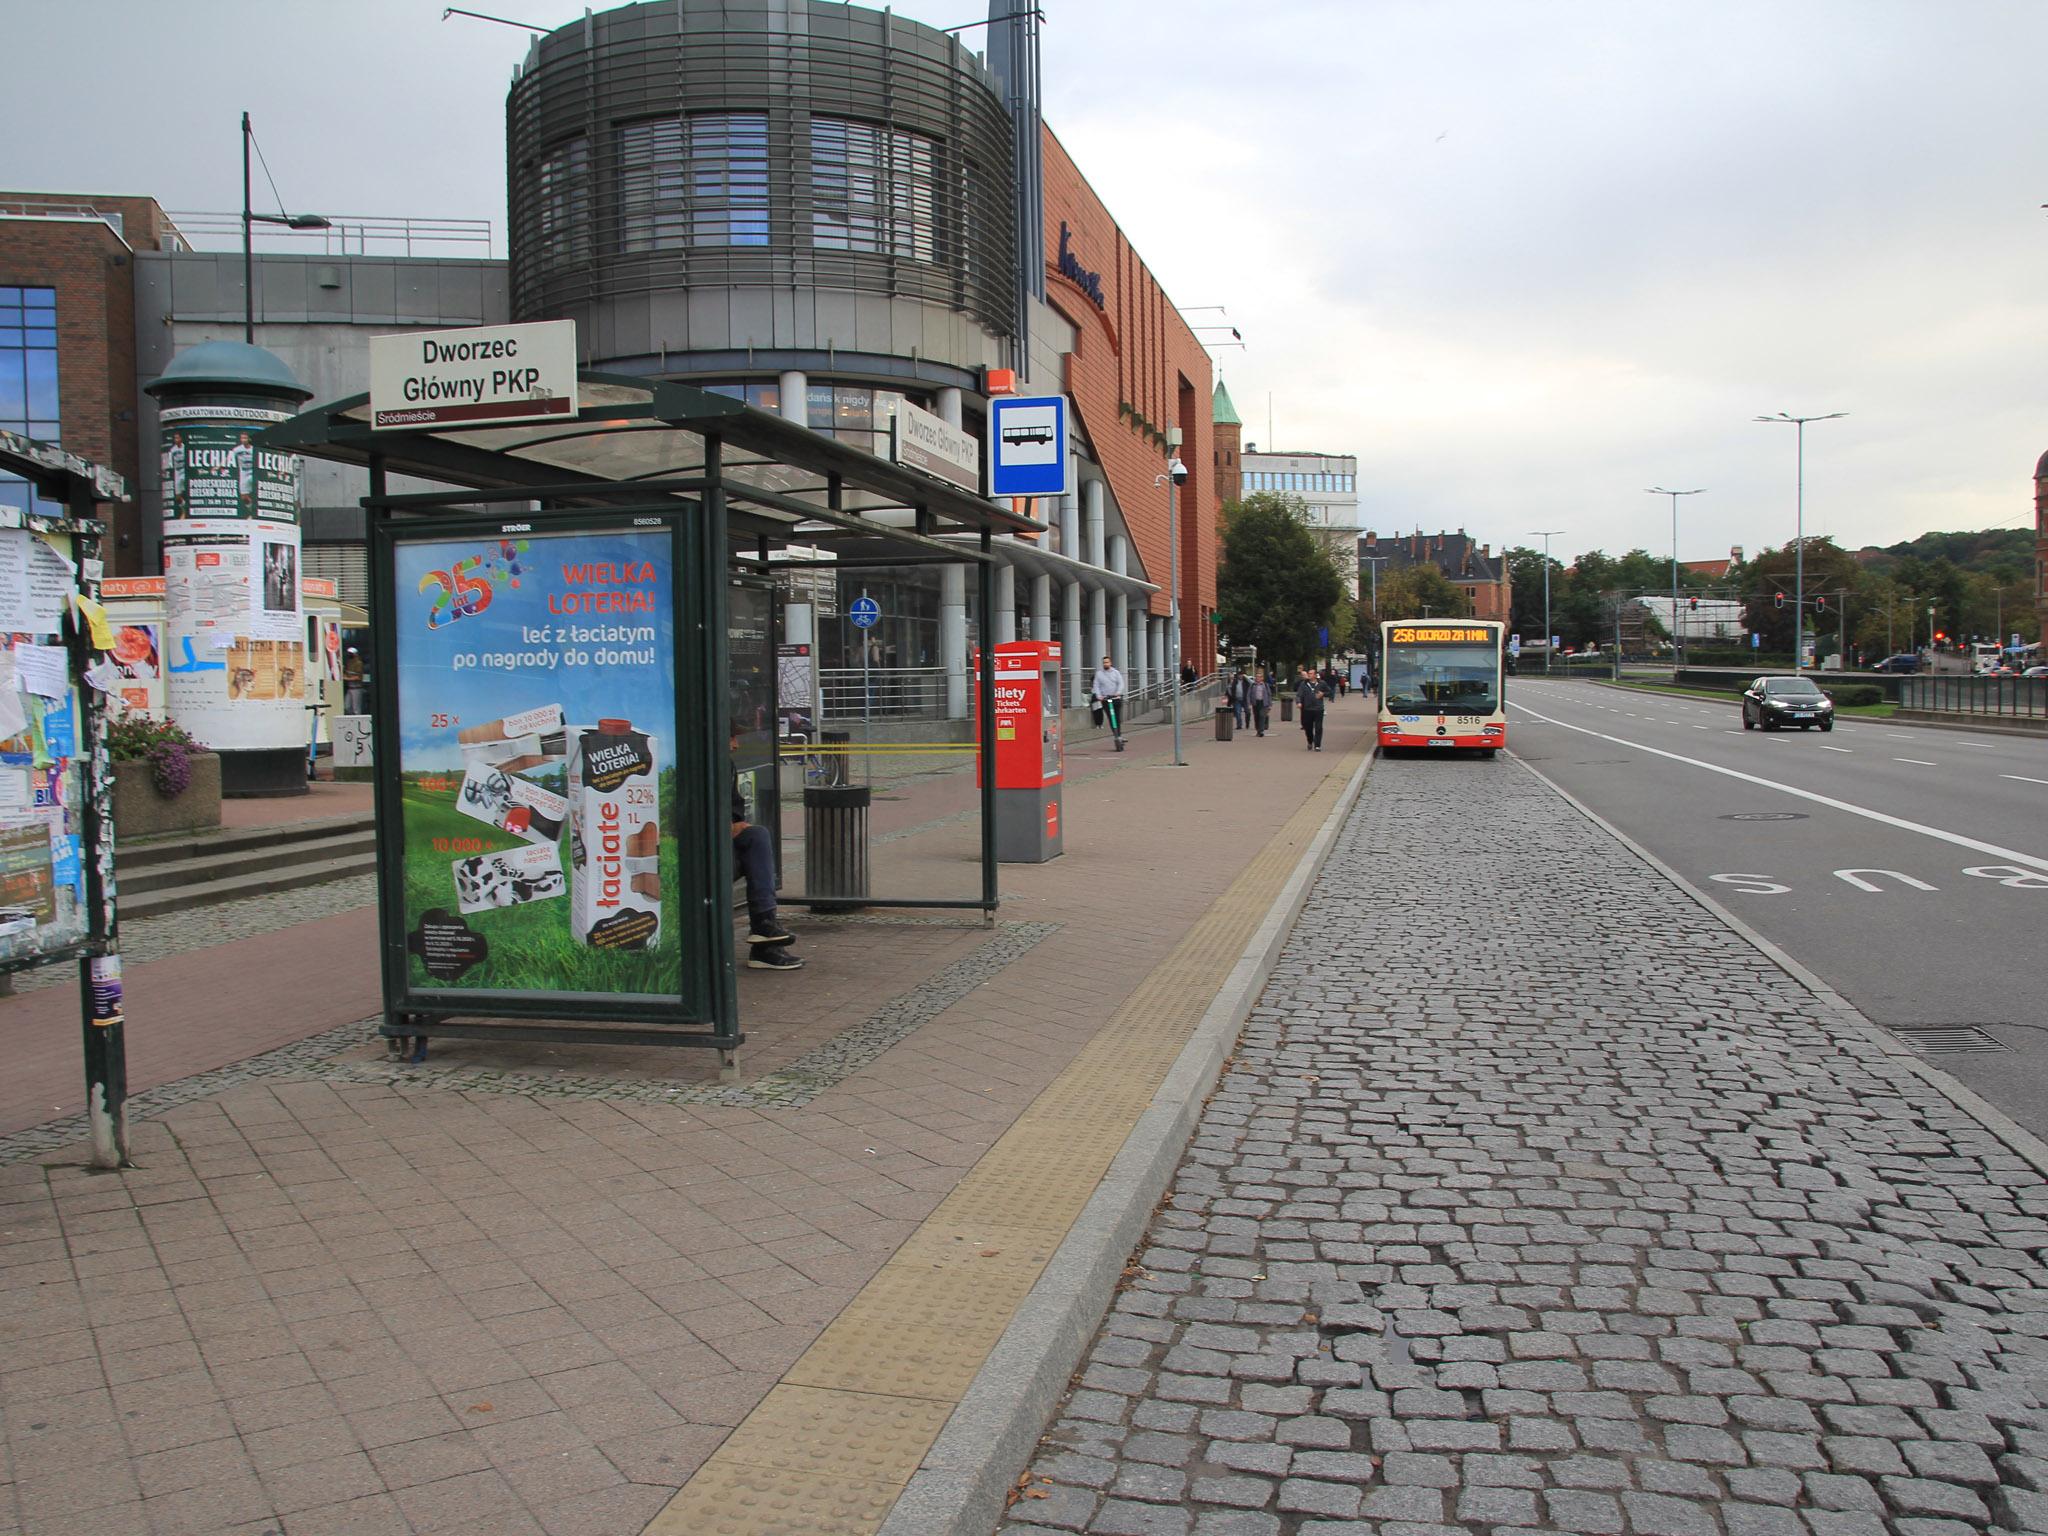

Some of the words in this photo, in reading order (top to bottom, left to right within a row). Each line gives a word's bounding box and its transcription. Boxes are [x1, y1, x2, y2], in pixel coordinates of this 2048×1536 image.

[423, 339, 517, 364] Dworzec
[404, 376, 485, 402] Główny
[493, 368, 539, 394] PKP
[233, 408, 269, 418] OUTDOOR
[378, 411, 437, 424] Śródmieście
[188, 449, 237, 468] LECHIA
[502, 523, 532, 533] STRÖER
[562, 561, 657, 585] WIELKA
[418, 554, 493, 630] 25
[548, 591, 655, 615] LOTERIA!
[523, 625, 551, 644] leć
[556, 630, 566, 642] z
[570, 625, 655, 647] łaciatym
[1393, 628, 1416, 642] 256
[1465, 630, 1471, 641] 1
[453, 654, 477, 671] po
[482, 650, 559, 670] nagrody
[564, 649, 589, 666] do
[594, 647, 655, 666] domu!
[431, 714, 448, 728] 25
[452, 716, 460, 725] x
[1457, 716, 1481, 724] 8516
[588, 743, 632, 763] WIELKA
[591, 753, 640, 775] LOTERIA!
[432, 837, 450, 852] 10
[451, 837, 483, 852] 000
[596, 802, 622, 908] łaciate
